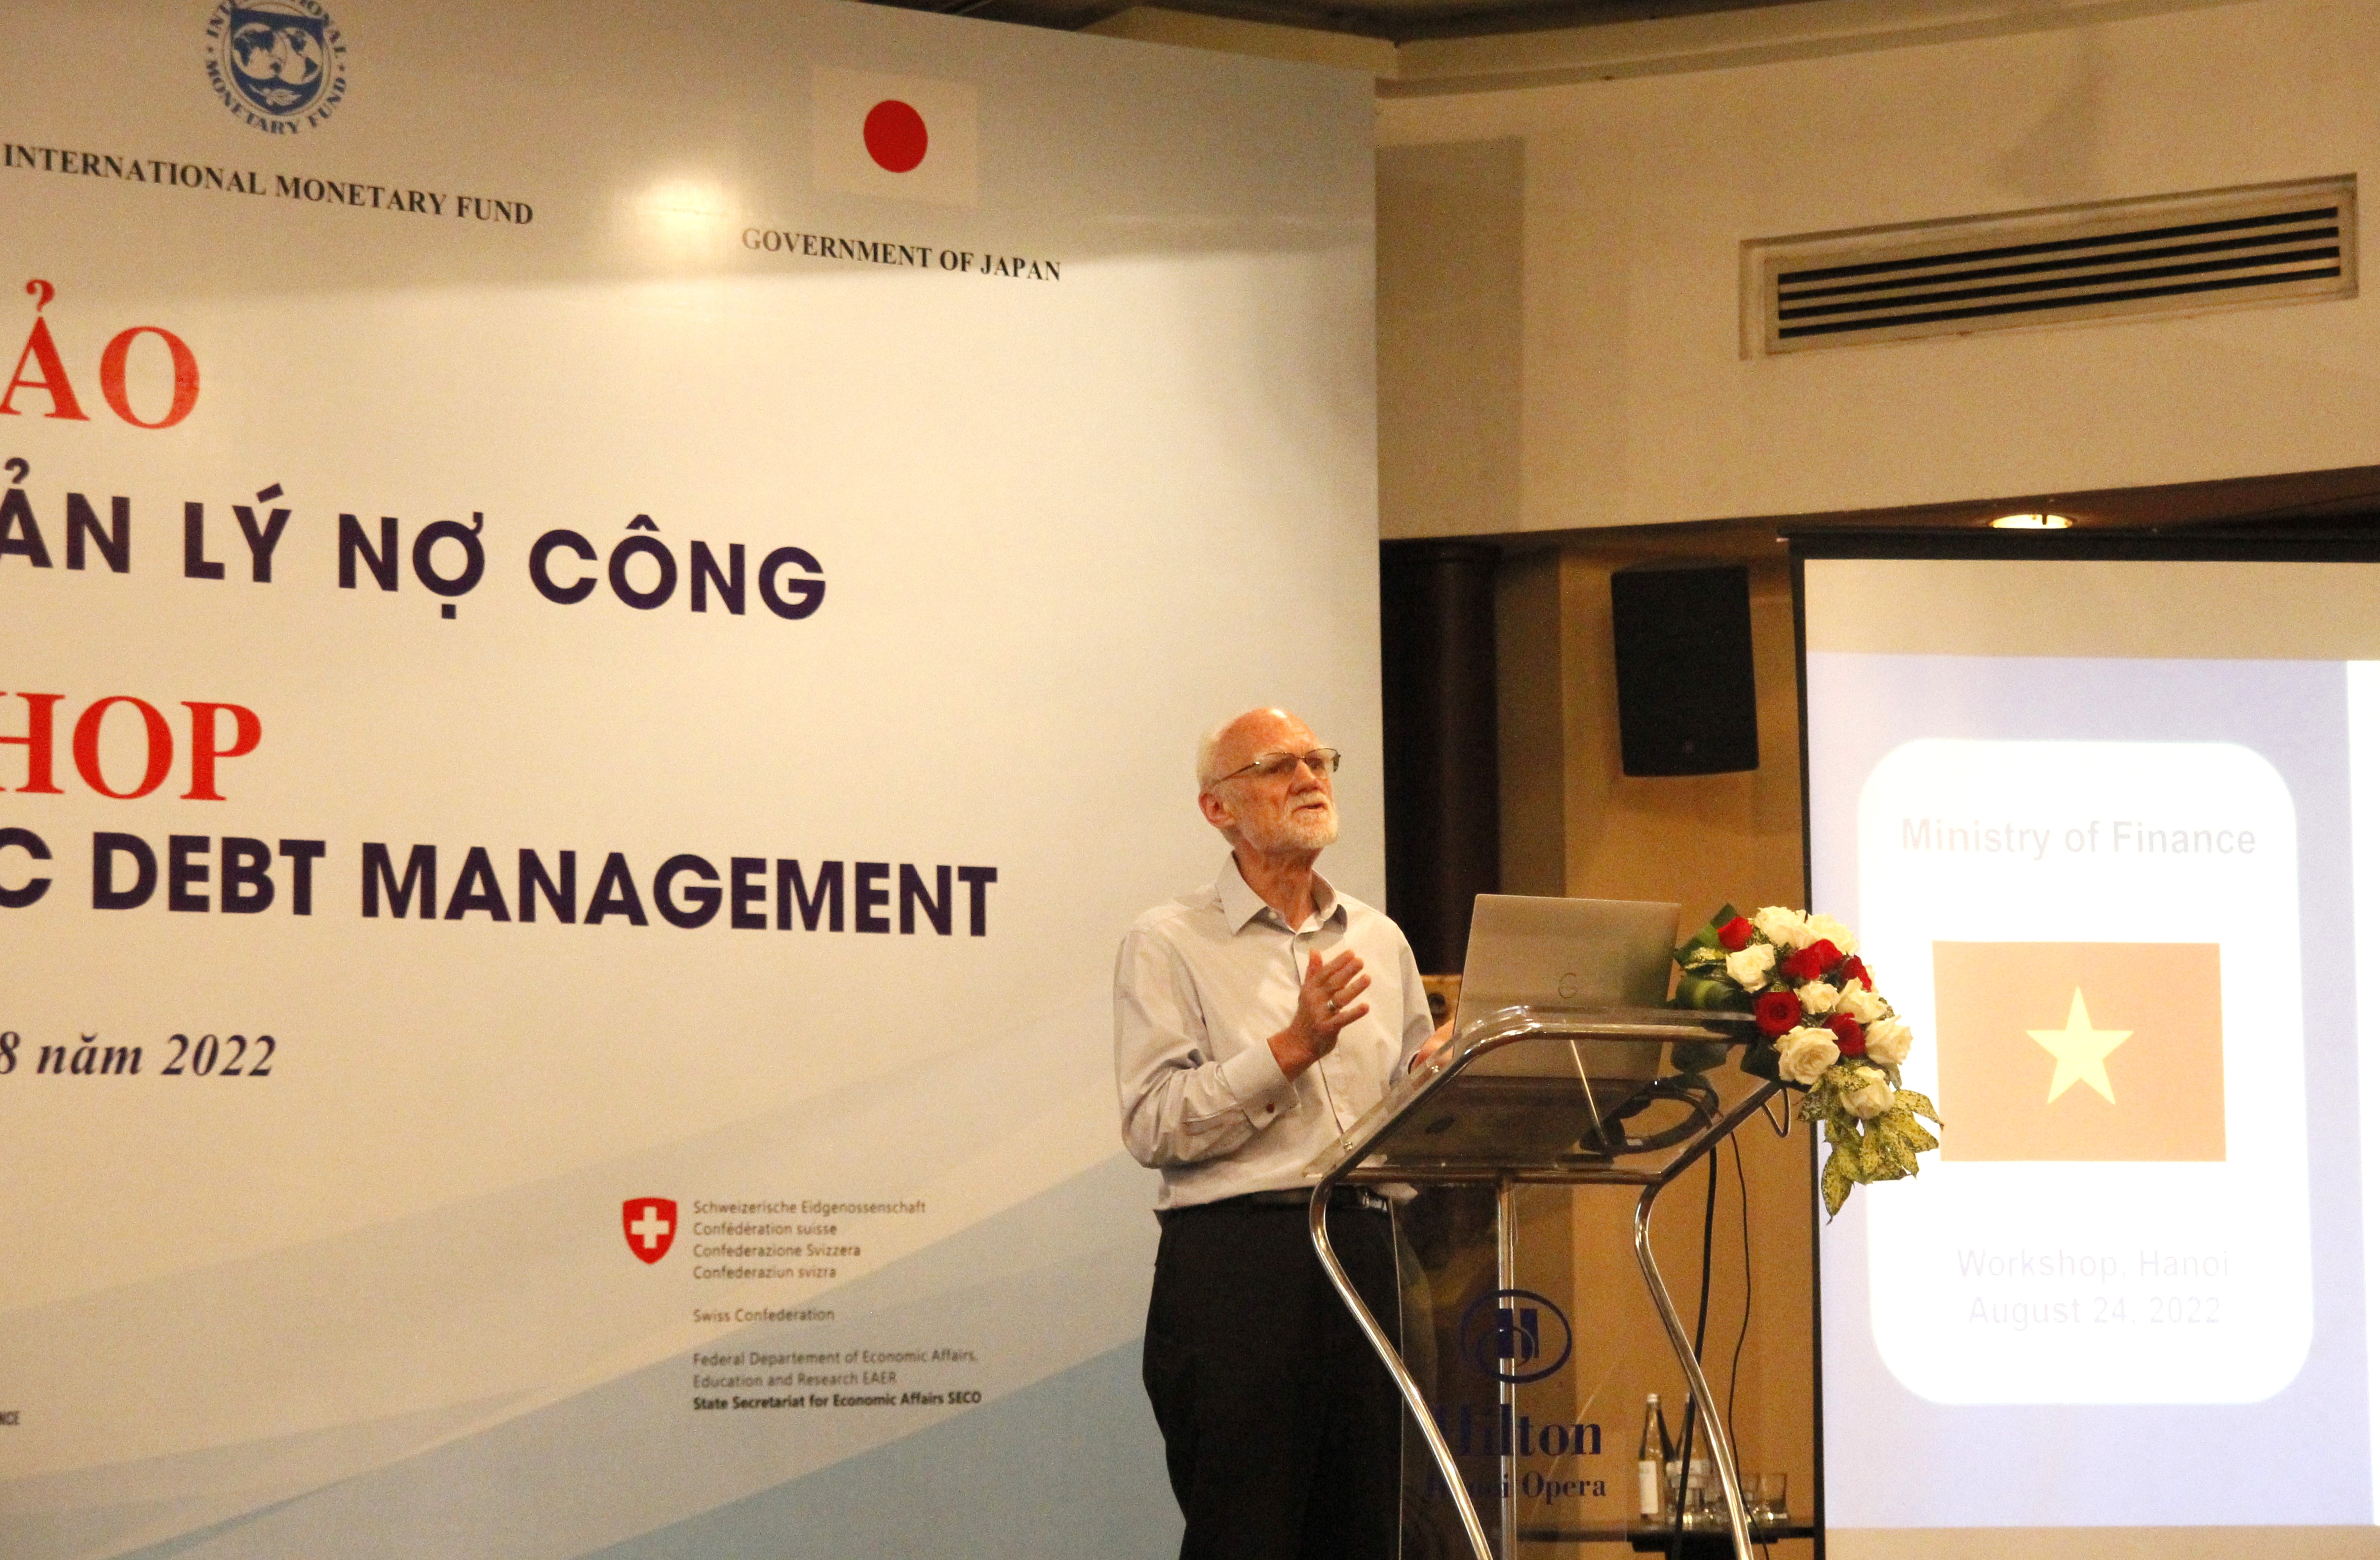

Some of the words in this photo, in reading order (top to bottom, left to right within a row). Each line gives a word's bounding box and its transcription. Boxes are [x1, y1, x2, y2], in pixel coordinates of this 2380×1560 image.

[205, 60, 298, 135] MONETARY
[308, 78, 346, 128] FUND
[4, 143, 266, 195] INTERNATIONAL
[276, 175, 446, 215] MONETARY
[457, 196, 533, 224] FUND
[742, 229, 932, 269] GOVERNMENT
[939, 250, 974, 272] OF
[980, 255, 1059, 280] JAPAN
[0, 279, 199, 429] ẢO
[184, 483, 291, 583] LÝ
[339, 511, 485, 620] NỢ
[529, 514, 825, 620] CÔNG
[1900, 817, 2051, 861] Ministry
[2064, 819, 2100, 854] of
[2112, 820, 2256, 855] Finance
[92, 832, 325, 916] DEBT
[362, 842, 997, 936] MANAGEMENT
[37, 1033, 142, 1075] năm
[161, 1034, 275, 1077] 2022
[694, 1201, 797, 1214] Schweizerische
[801, 1200, 926, 1217] Eidgenossenschaft
[693, 1221, 792, 1236] Confédération
[797, 1225, 837, 1235] suisse
[693, 1244, 802, 1257] Confederazione
[807, 1243, 860, 1256] Svizzera
[2139, 1249, 2228, 1277] Hanoi
[693, 1265, 793, 1280] Confederaziun
[798, 1268, 836, 1278] svizra
[693, 1309, 731, 1323] Swiss
[735, 1308, 834, 1322] Confederation
[1968, 1296, 2081, 1331] August
[2149, 1296, 2220, 1324] 2022
[693, 1353, 744, 1366] Federal
[845, 1350, 858, 1363] of
[862, 1350, 927, 1364] Economic
[693, 1374, 763, 1389] Education
[768, 1374, 793, 1387] and
[797, 1372, 858, 1386] Research
[863, 1371, 896, 1384] EAER
[693, 1397, 728, 1410] State
[733, 1396, 805, 1409] Secretariat
[809, 1394, 828, 1407] for
[833, 1394, 896, 1407] Economic
[900, 1392, 944, 1404] Affairs
[948, 1391, 981, 1404] SECO
[1522, 1471, 1606, 1505] Opera
